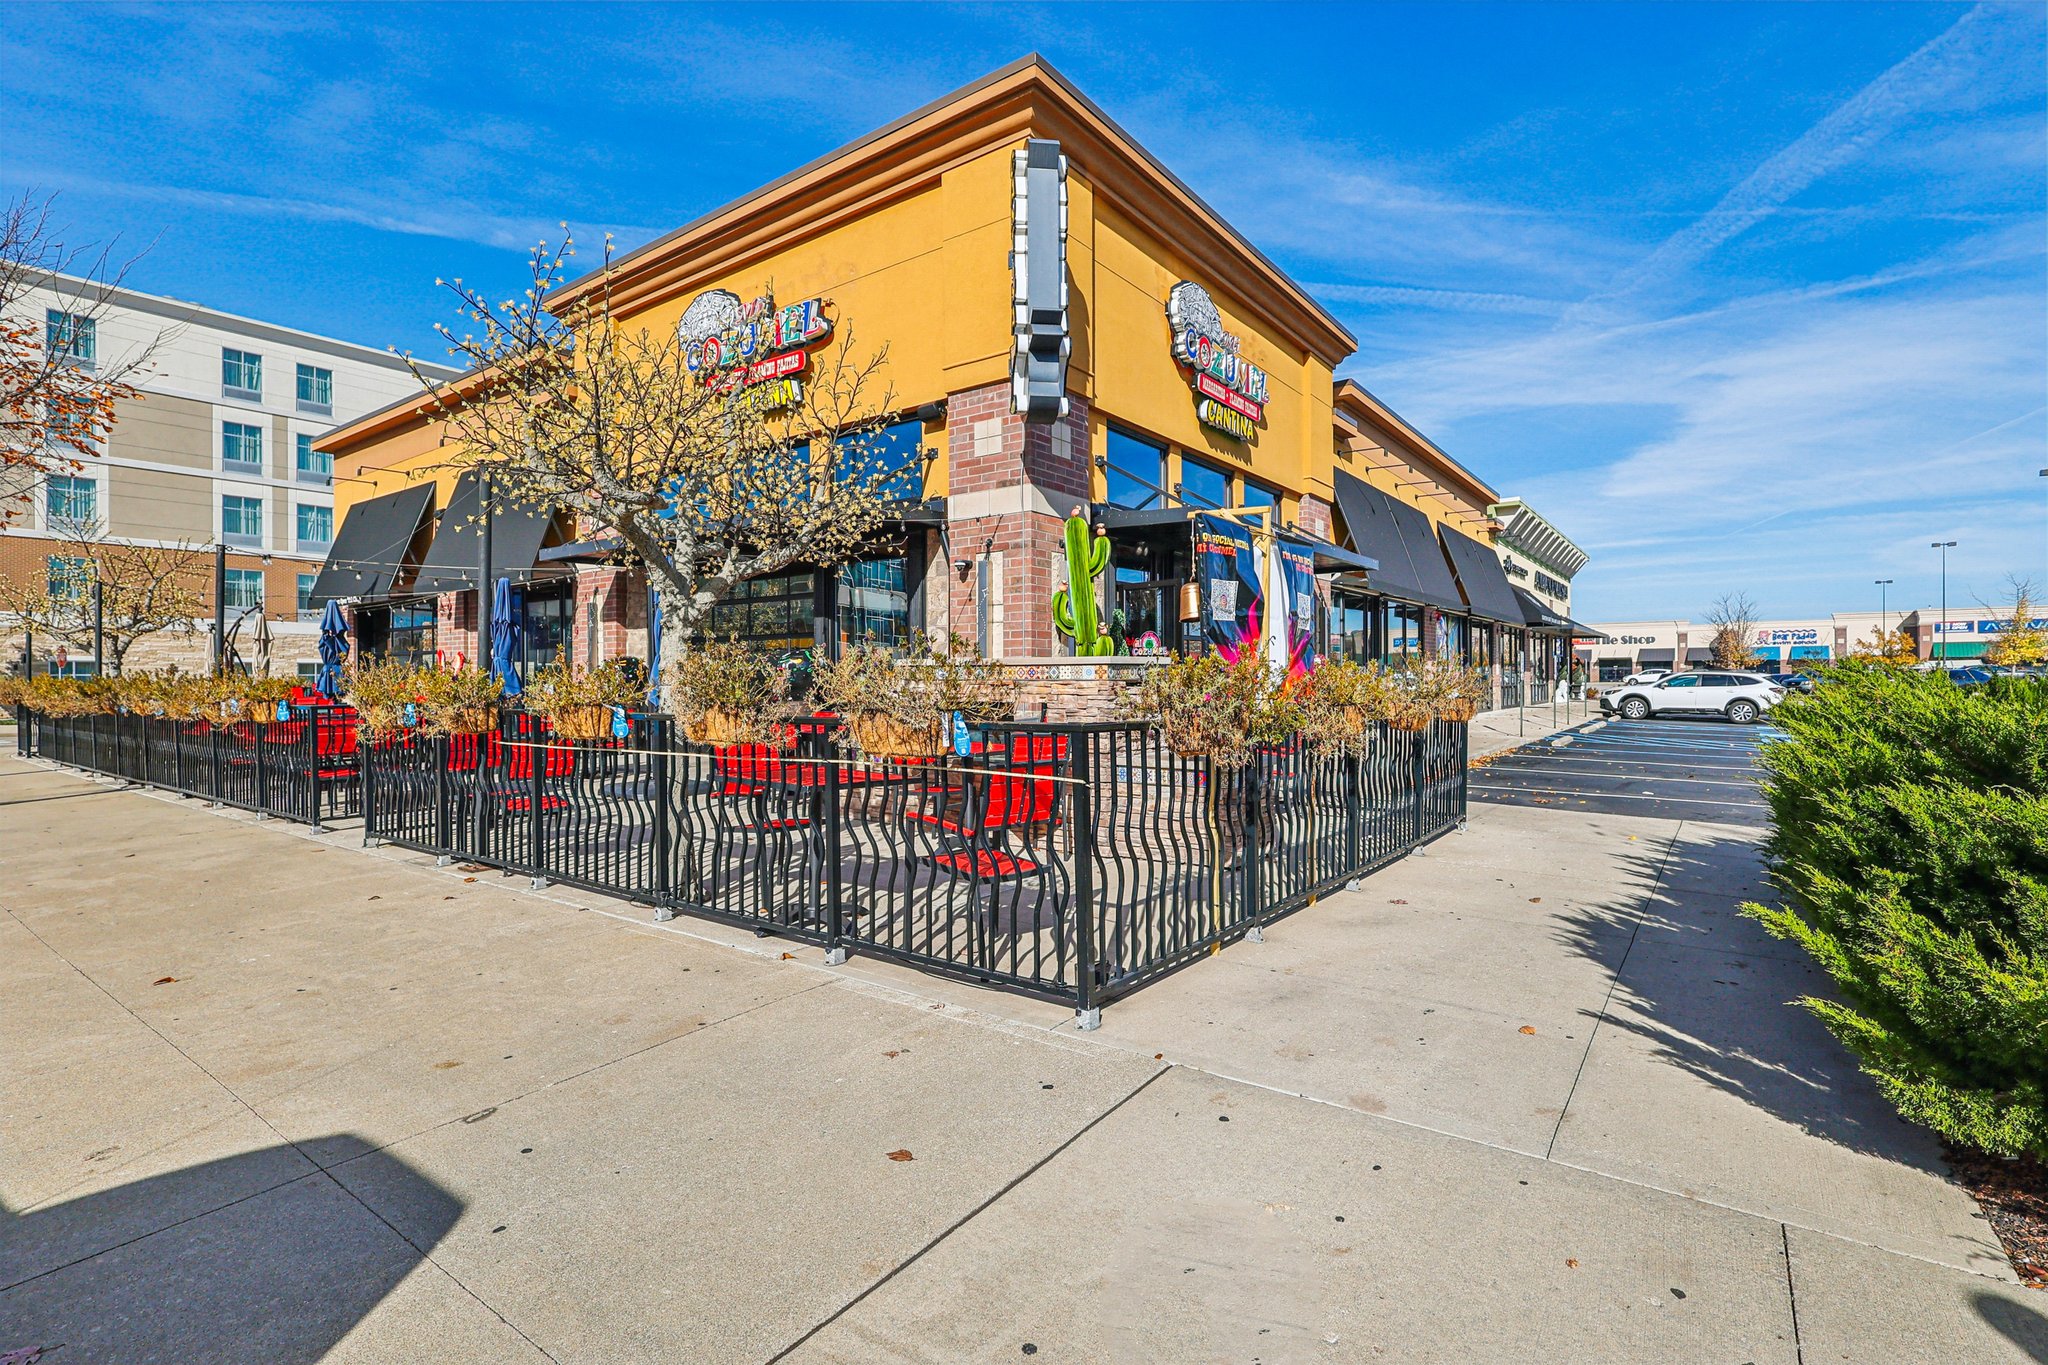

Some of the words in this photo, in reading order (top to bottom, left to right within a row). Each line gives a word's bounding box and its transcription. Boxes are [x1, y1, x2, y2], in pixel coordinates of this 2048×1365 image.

[1185, 328, 1270, 404] COZUMEL
[1207, 400, 1254, 440] CANTINA
[1212, 535, 1235, 547] SOCIAL
[1620, 635, 1656, 645] Shop
[1772, 633, 1789, 641] Bear
[1791, 632, 1818, 640] Paddle
